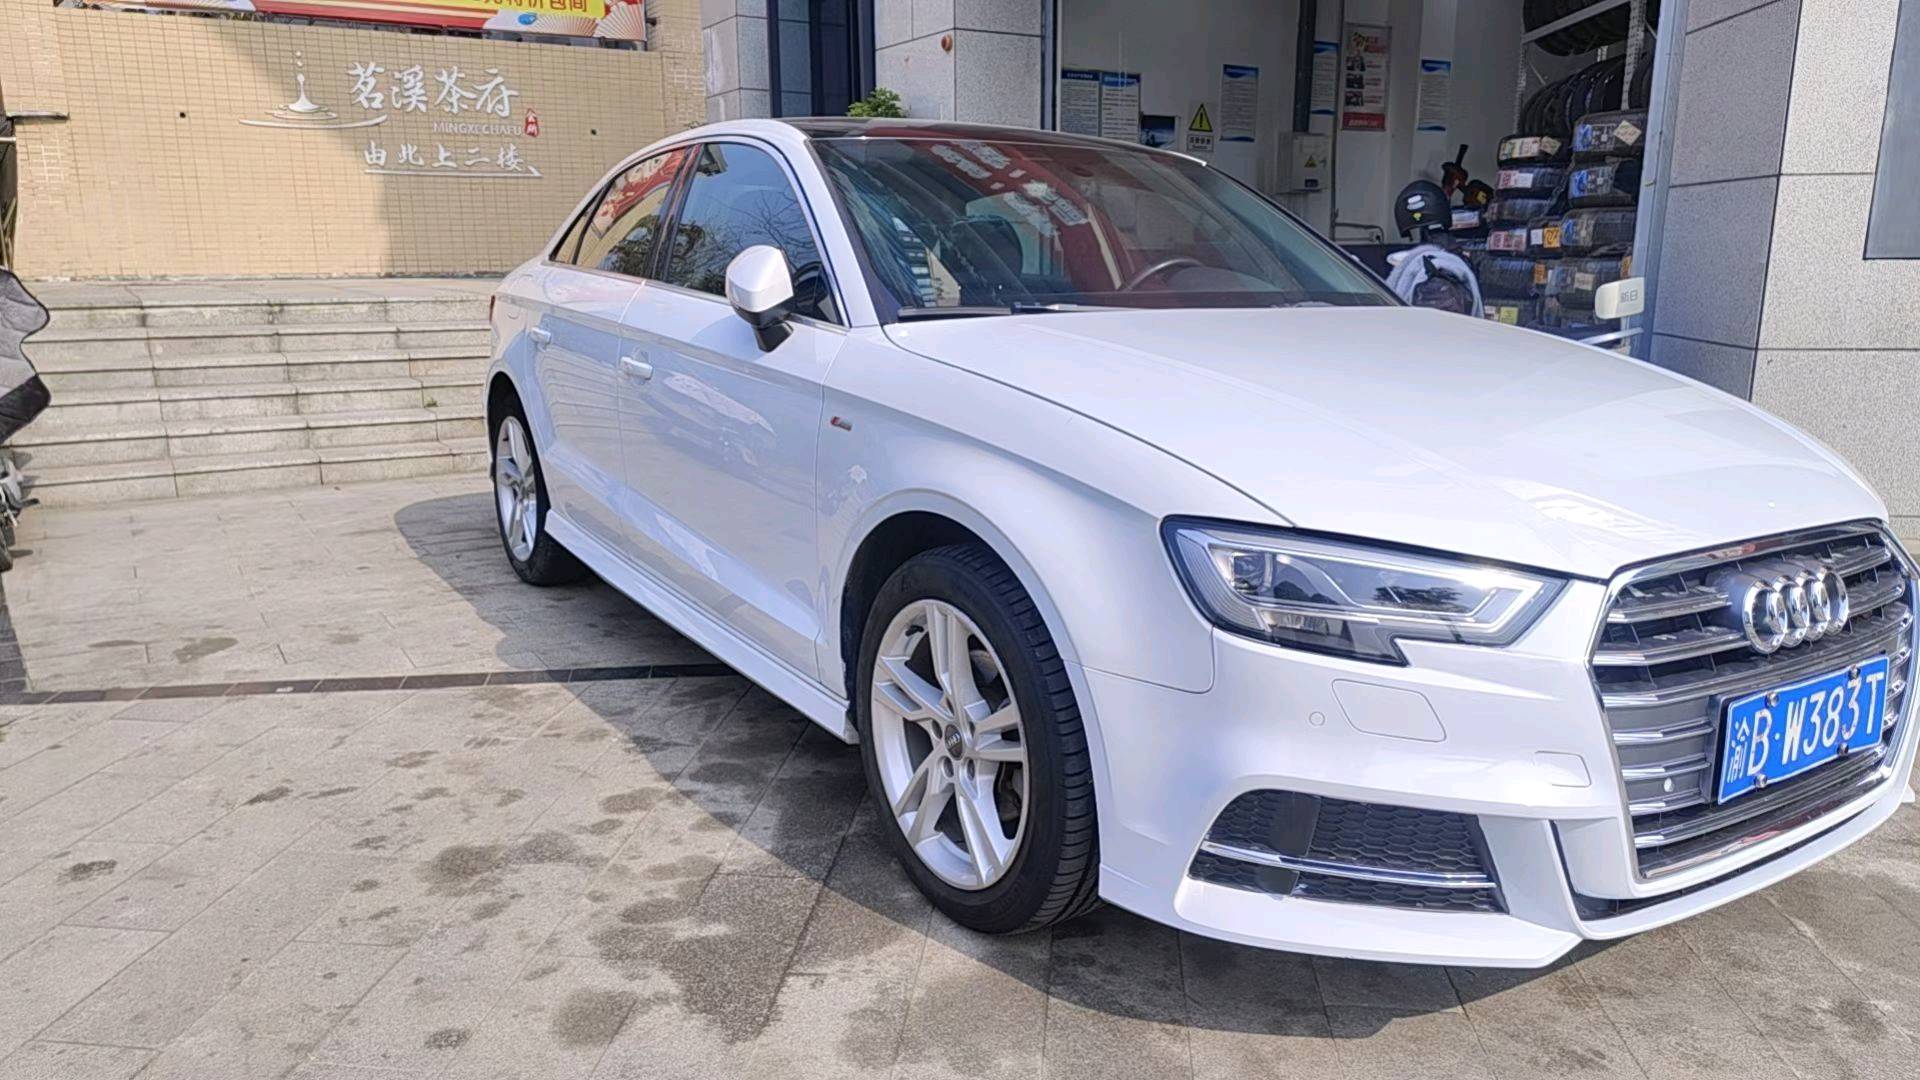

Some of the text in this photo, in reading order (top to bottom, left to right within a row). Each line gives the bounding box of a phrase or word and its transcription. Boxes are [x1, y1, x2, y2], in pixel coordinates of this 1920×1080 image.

[348, 61, 519, 117] 茗溪茶府
[364, 140, 524, 171] 由此上二楼
